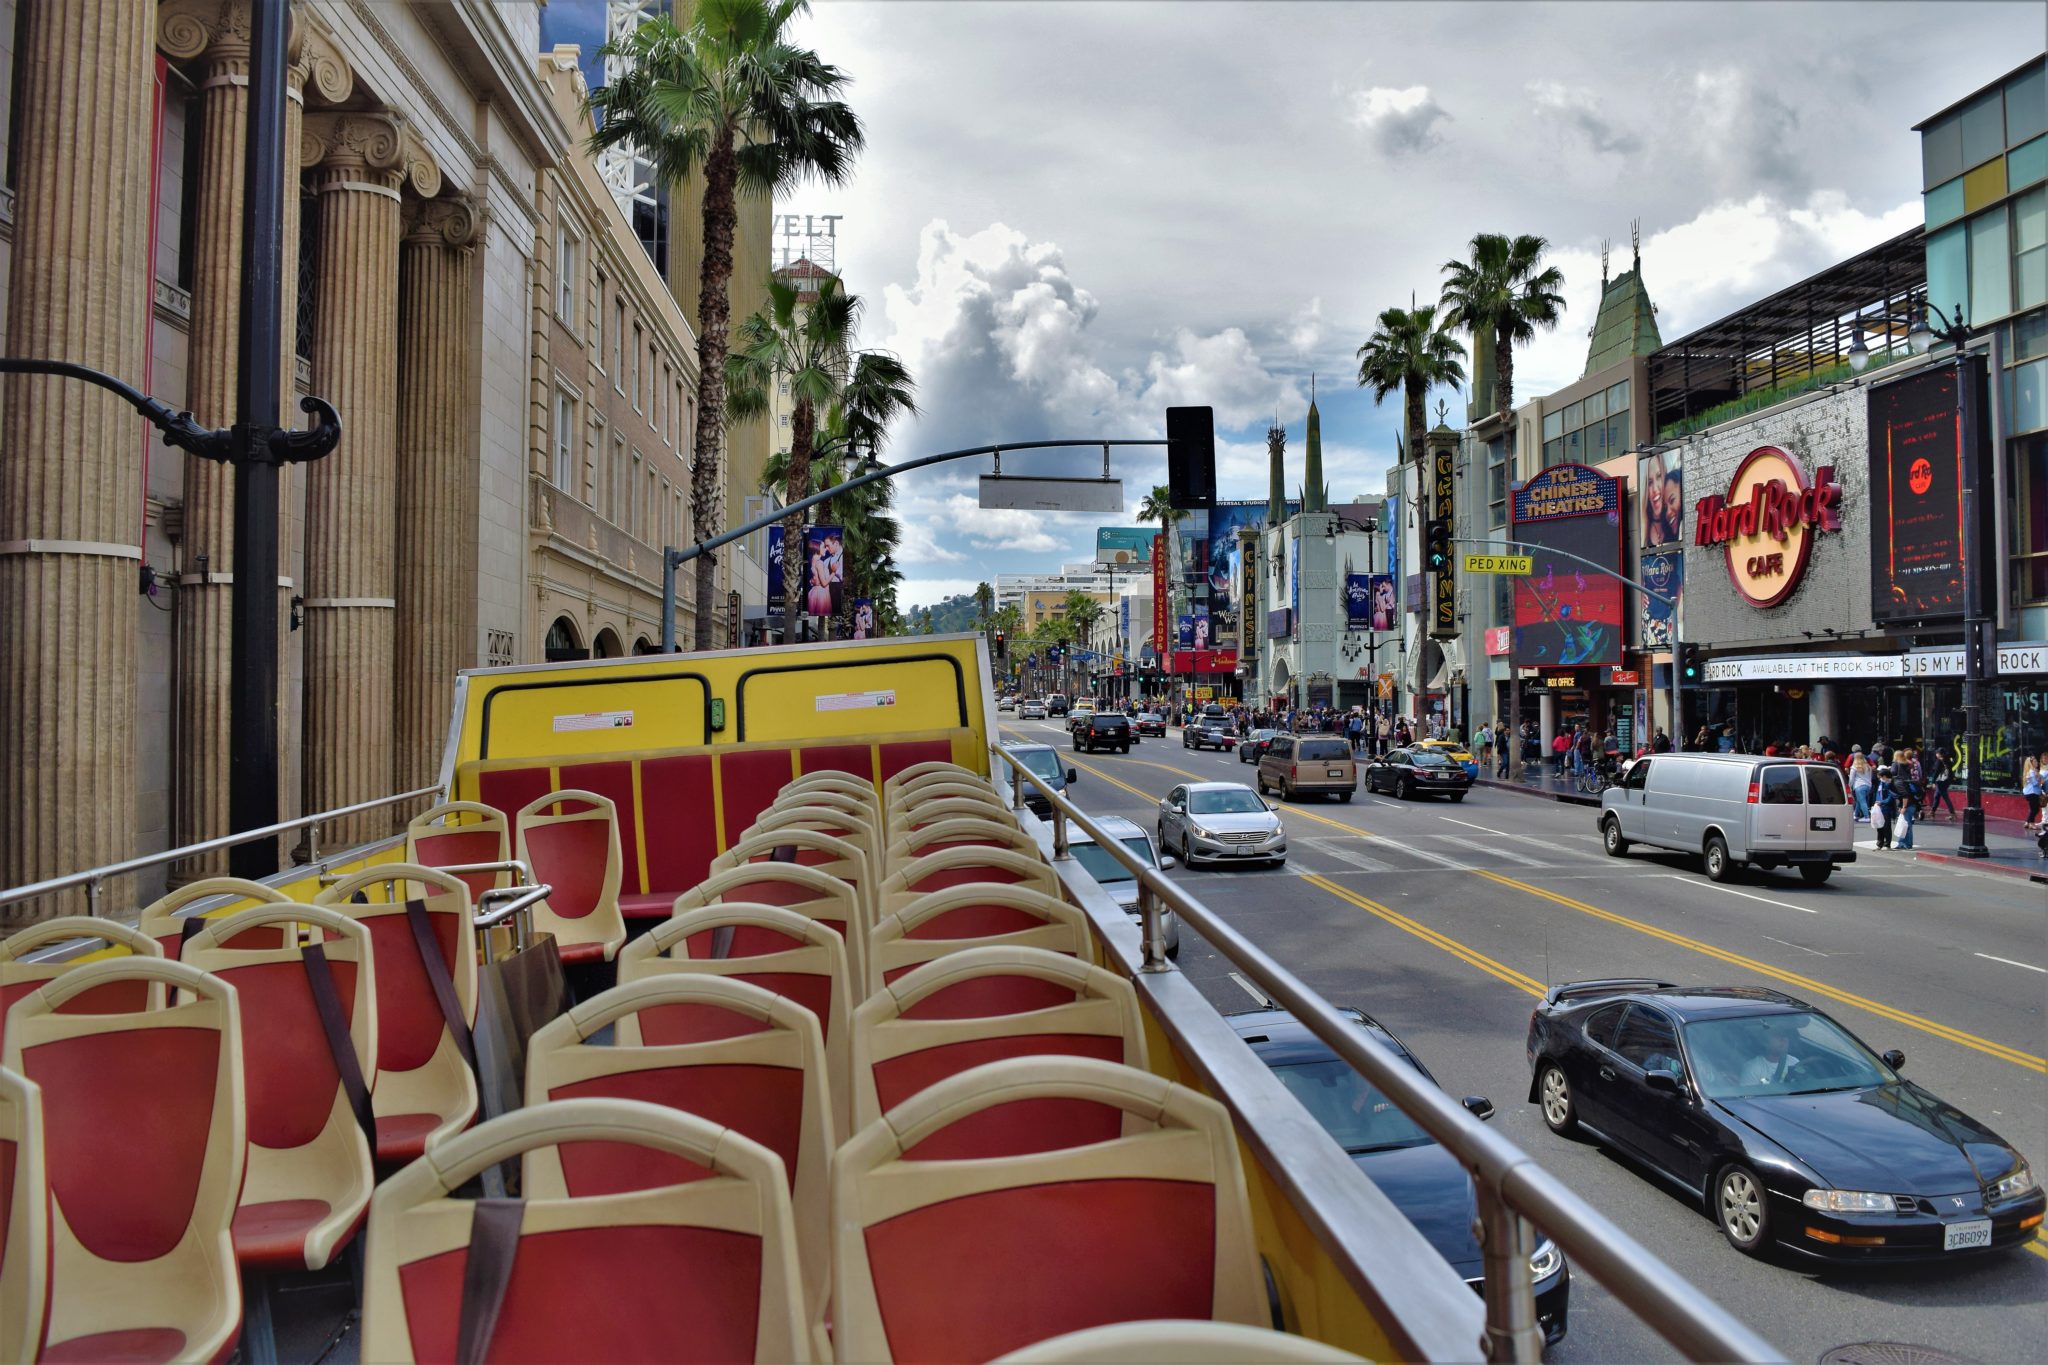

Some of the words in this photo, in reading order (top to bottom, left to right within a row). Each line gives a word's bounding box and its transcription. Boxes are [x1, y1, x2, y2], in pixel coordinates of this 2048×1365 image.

[1549, 469, 1578, 484] TCL
[1530, 480, 1598, 502] CHINESE
[1525, 495, 1605, 518] THEATRES
[1694, 482, 1764, 546] Hard
[1762, 465, 1843, 542] Rock
[1156, 537, 1164, 585] MADAME
[1469, 558, 1494, 570] PED
[1498, 559, 1527, 571] XING
[1746, 552, 1784, 578] CAFE
[1244, 550, 1255, 648] CHINESE
[1140, 658, 1157, 669] LA
[1721, 663, 1743, 677] ROCK
[1752, 662, 1794, 674] AVAILABLE
[1796, 663, 1808, 673] AT
[1811, 662, 1829, 673] THE
[1833, 661, 1862, 672] ROCK
[1866, 661, 1895, 672] SHOP
[1916, 657, 1927, 672] IS
[1933, 656, 1951, 672] MY
[2000, 652, 2040, 670] ROCK
[1547, 678, 1557, 686] BOX
[1558, 677, 1575, 686] OFFICE
[2003, 692, 2039, 712] THS
[1947, 1229, 1989, 1246] 3CBG099
